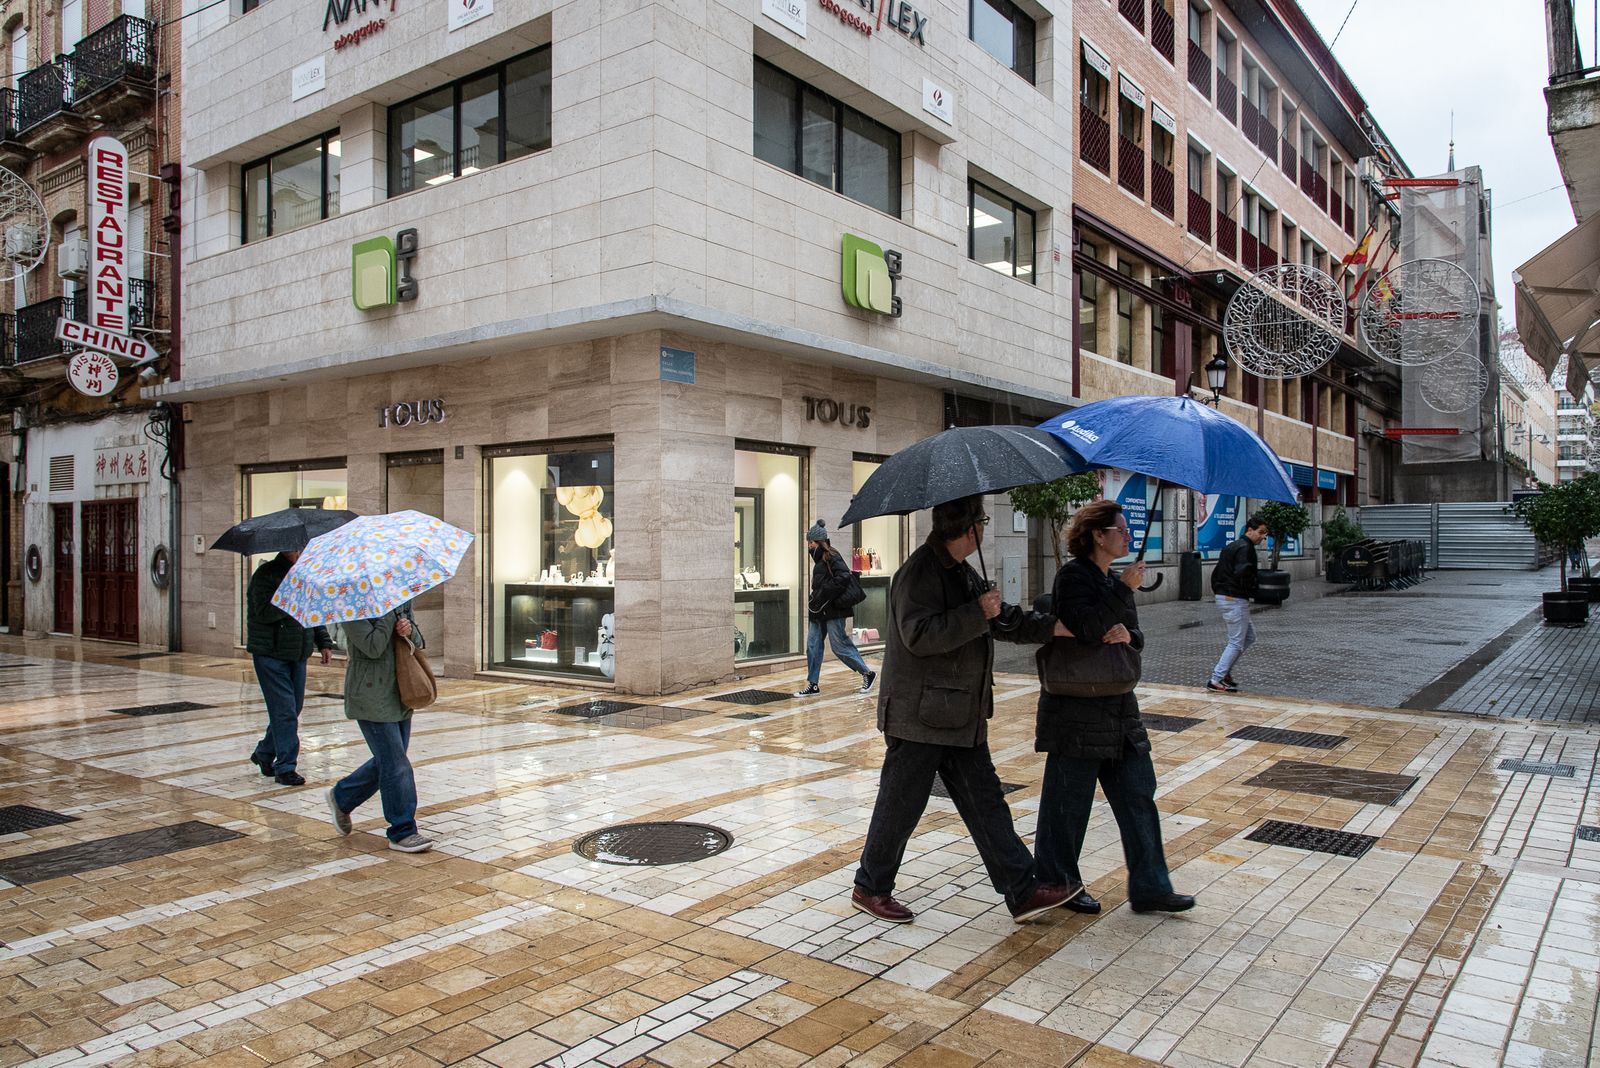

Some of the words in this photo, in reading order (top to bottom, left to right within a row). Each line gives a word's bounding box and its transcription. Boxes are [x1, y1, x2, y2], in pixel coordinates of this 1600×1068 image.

[334, 18, 386, 49] abogados
[97, 149, 123, 329] RESTAURANTE
[63, 322, 147, 358] CHINO
[91, 353, 117, 381] DIVINO
[802, 395, 872, 428] TOUS
